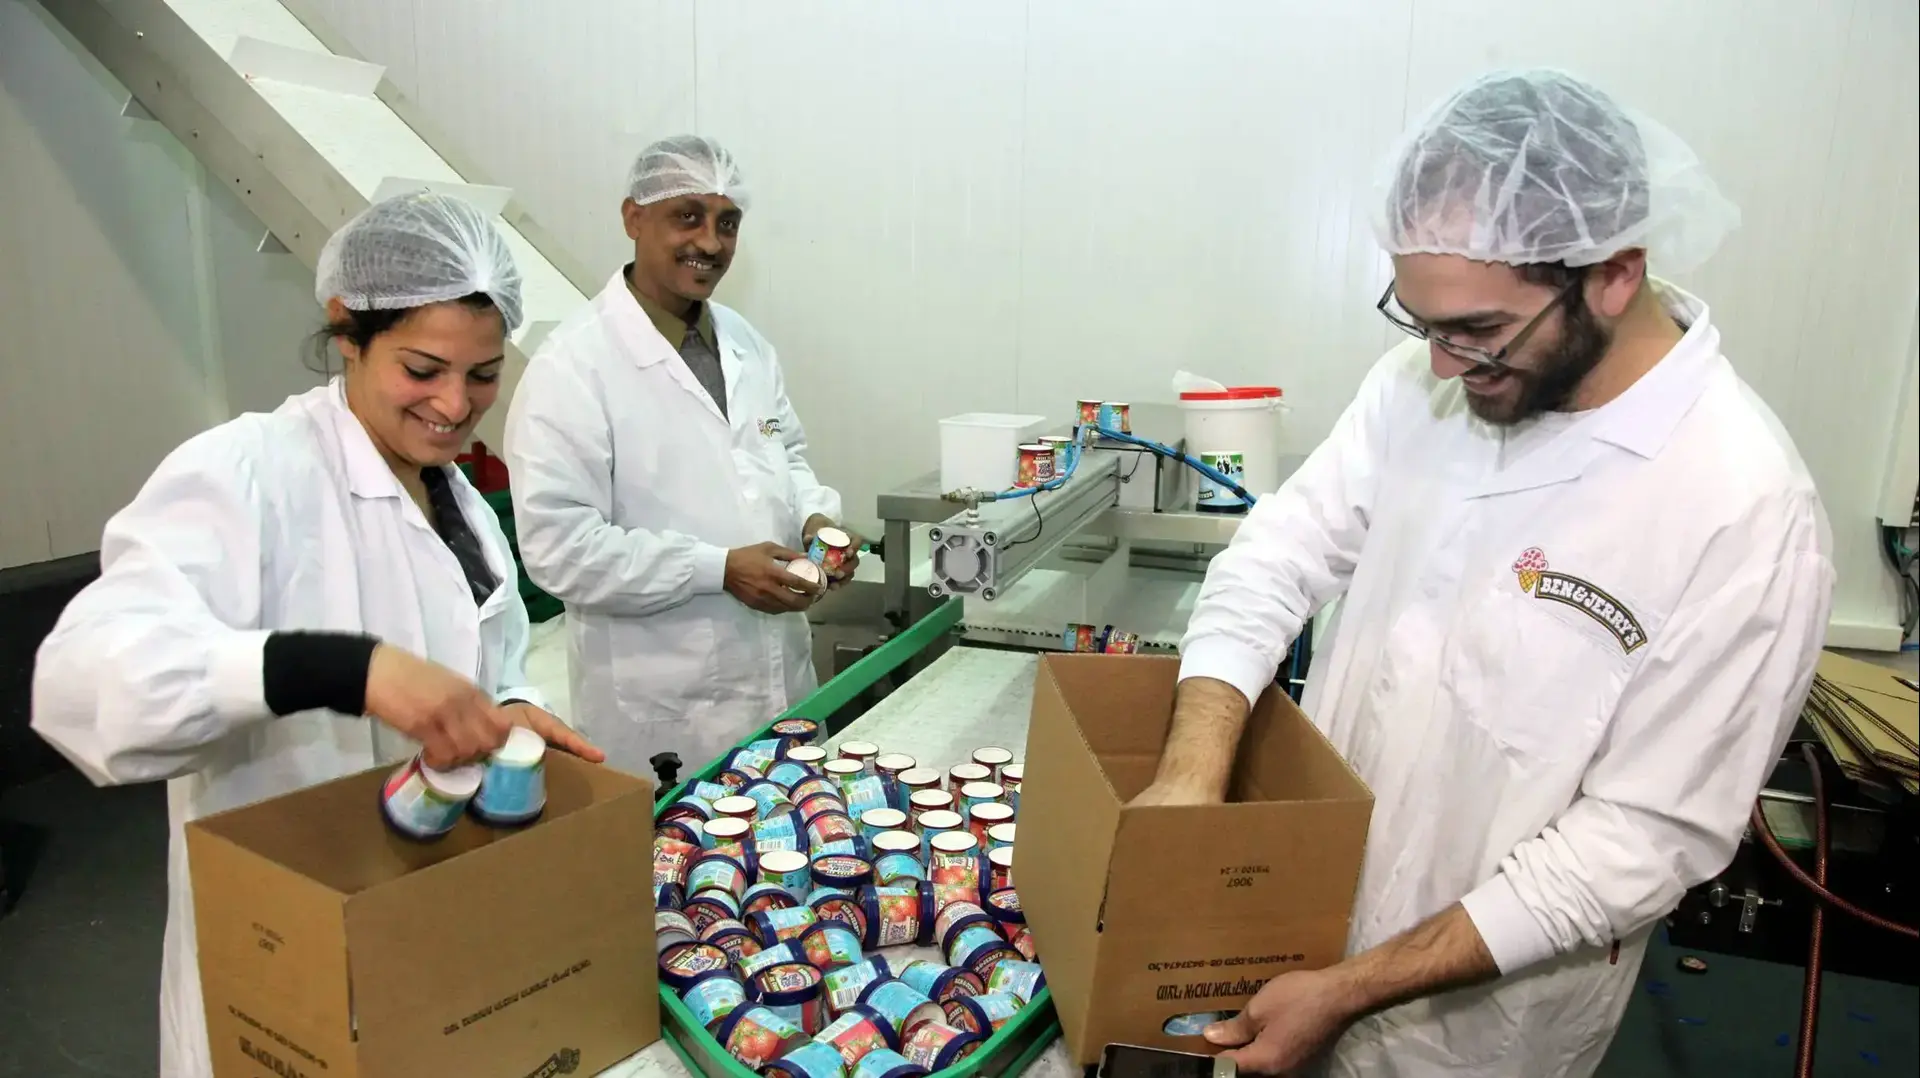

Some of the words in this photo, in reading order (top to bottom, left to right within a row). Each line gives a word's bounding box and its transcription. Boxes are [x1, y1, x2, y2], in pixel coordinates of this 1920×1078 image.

[1541, 577, 1641, 647] BEN&JERRY'S
[1226, 877, 1254, 888] 3067
[1156, 983, 1182, 1001] מוצרי
